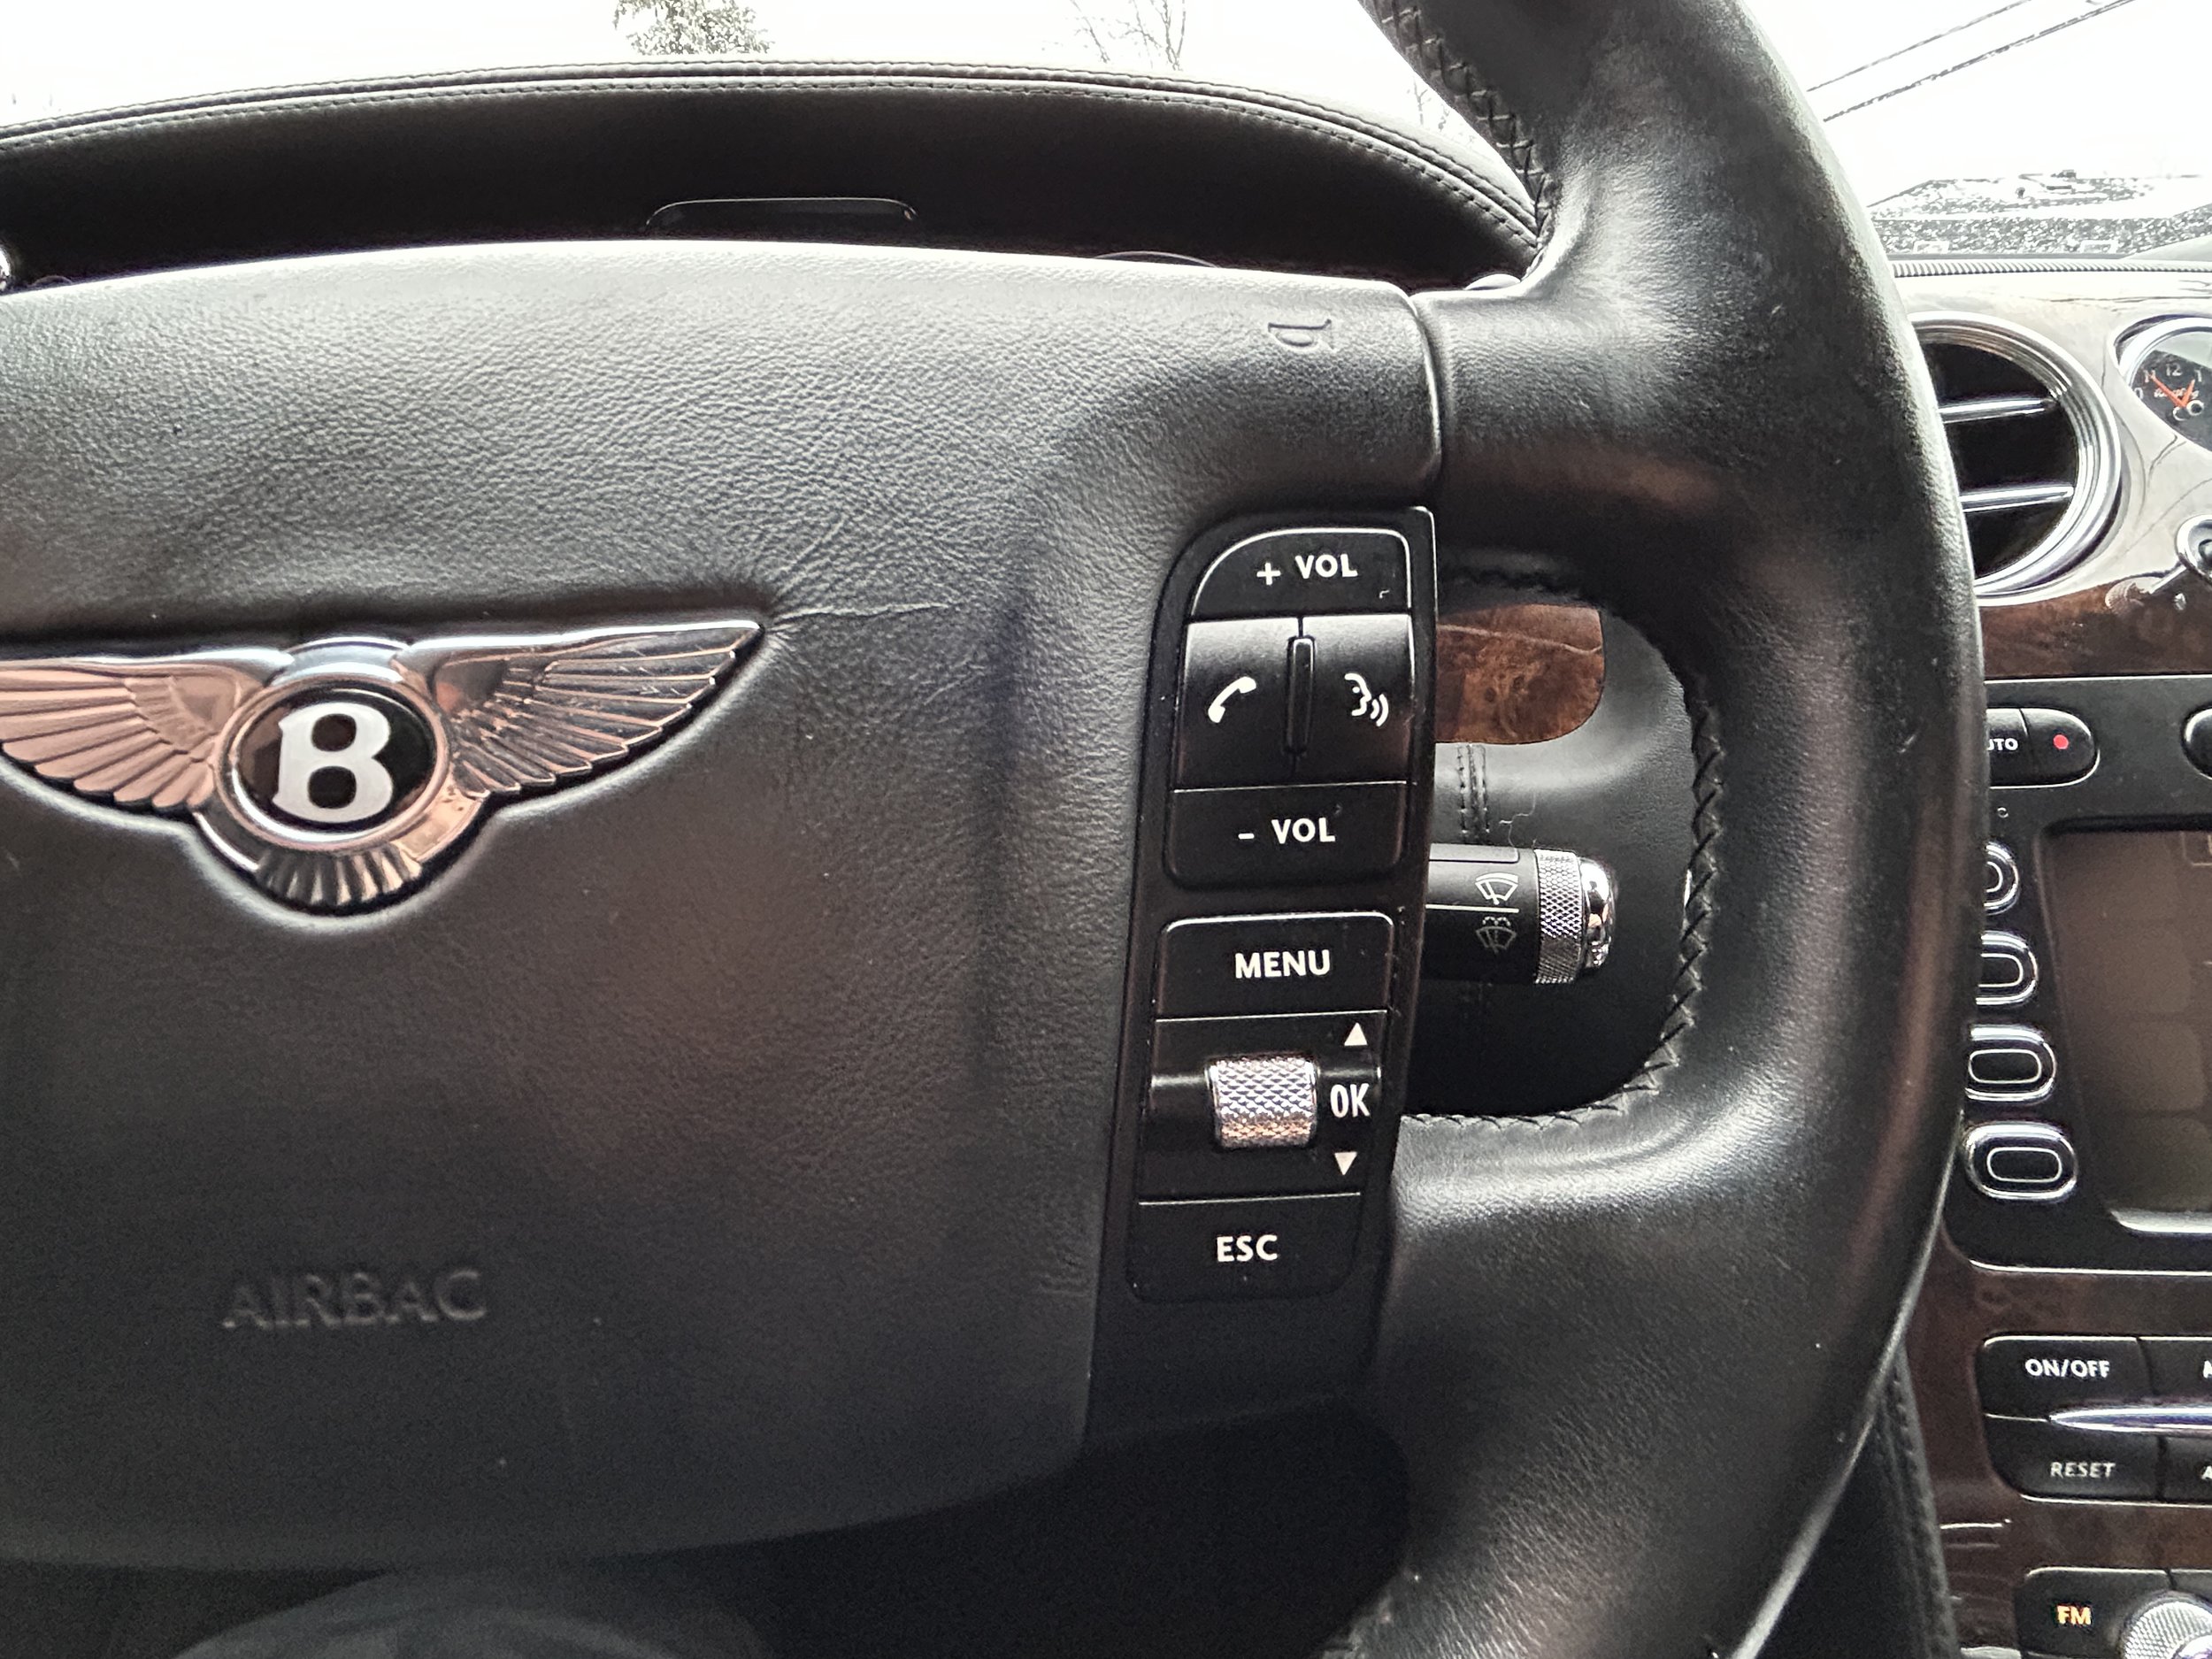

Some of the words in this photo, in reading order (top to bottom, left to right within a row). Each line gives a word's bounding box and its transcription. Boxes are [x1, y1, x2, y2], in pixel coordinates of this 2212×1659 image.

[2165, 362, 2183, 377] 12
[1294, 553, 1358, 580] VOL
[273, 701, 394, 825] B
[1271, 817, 1336, 844] VOL
[1234, 949, 1331, 979] MENU
[1329, 1082, 1371, 1118] OK
[1217, 1233, 1279, 1263] ESC
[2024, 1358, 2111, 1379] ON/OFF
[2049, 1462, 2116, 1479] RESET
[2056, 1605, 2093, 1625] FM
